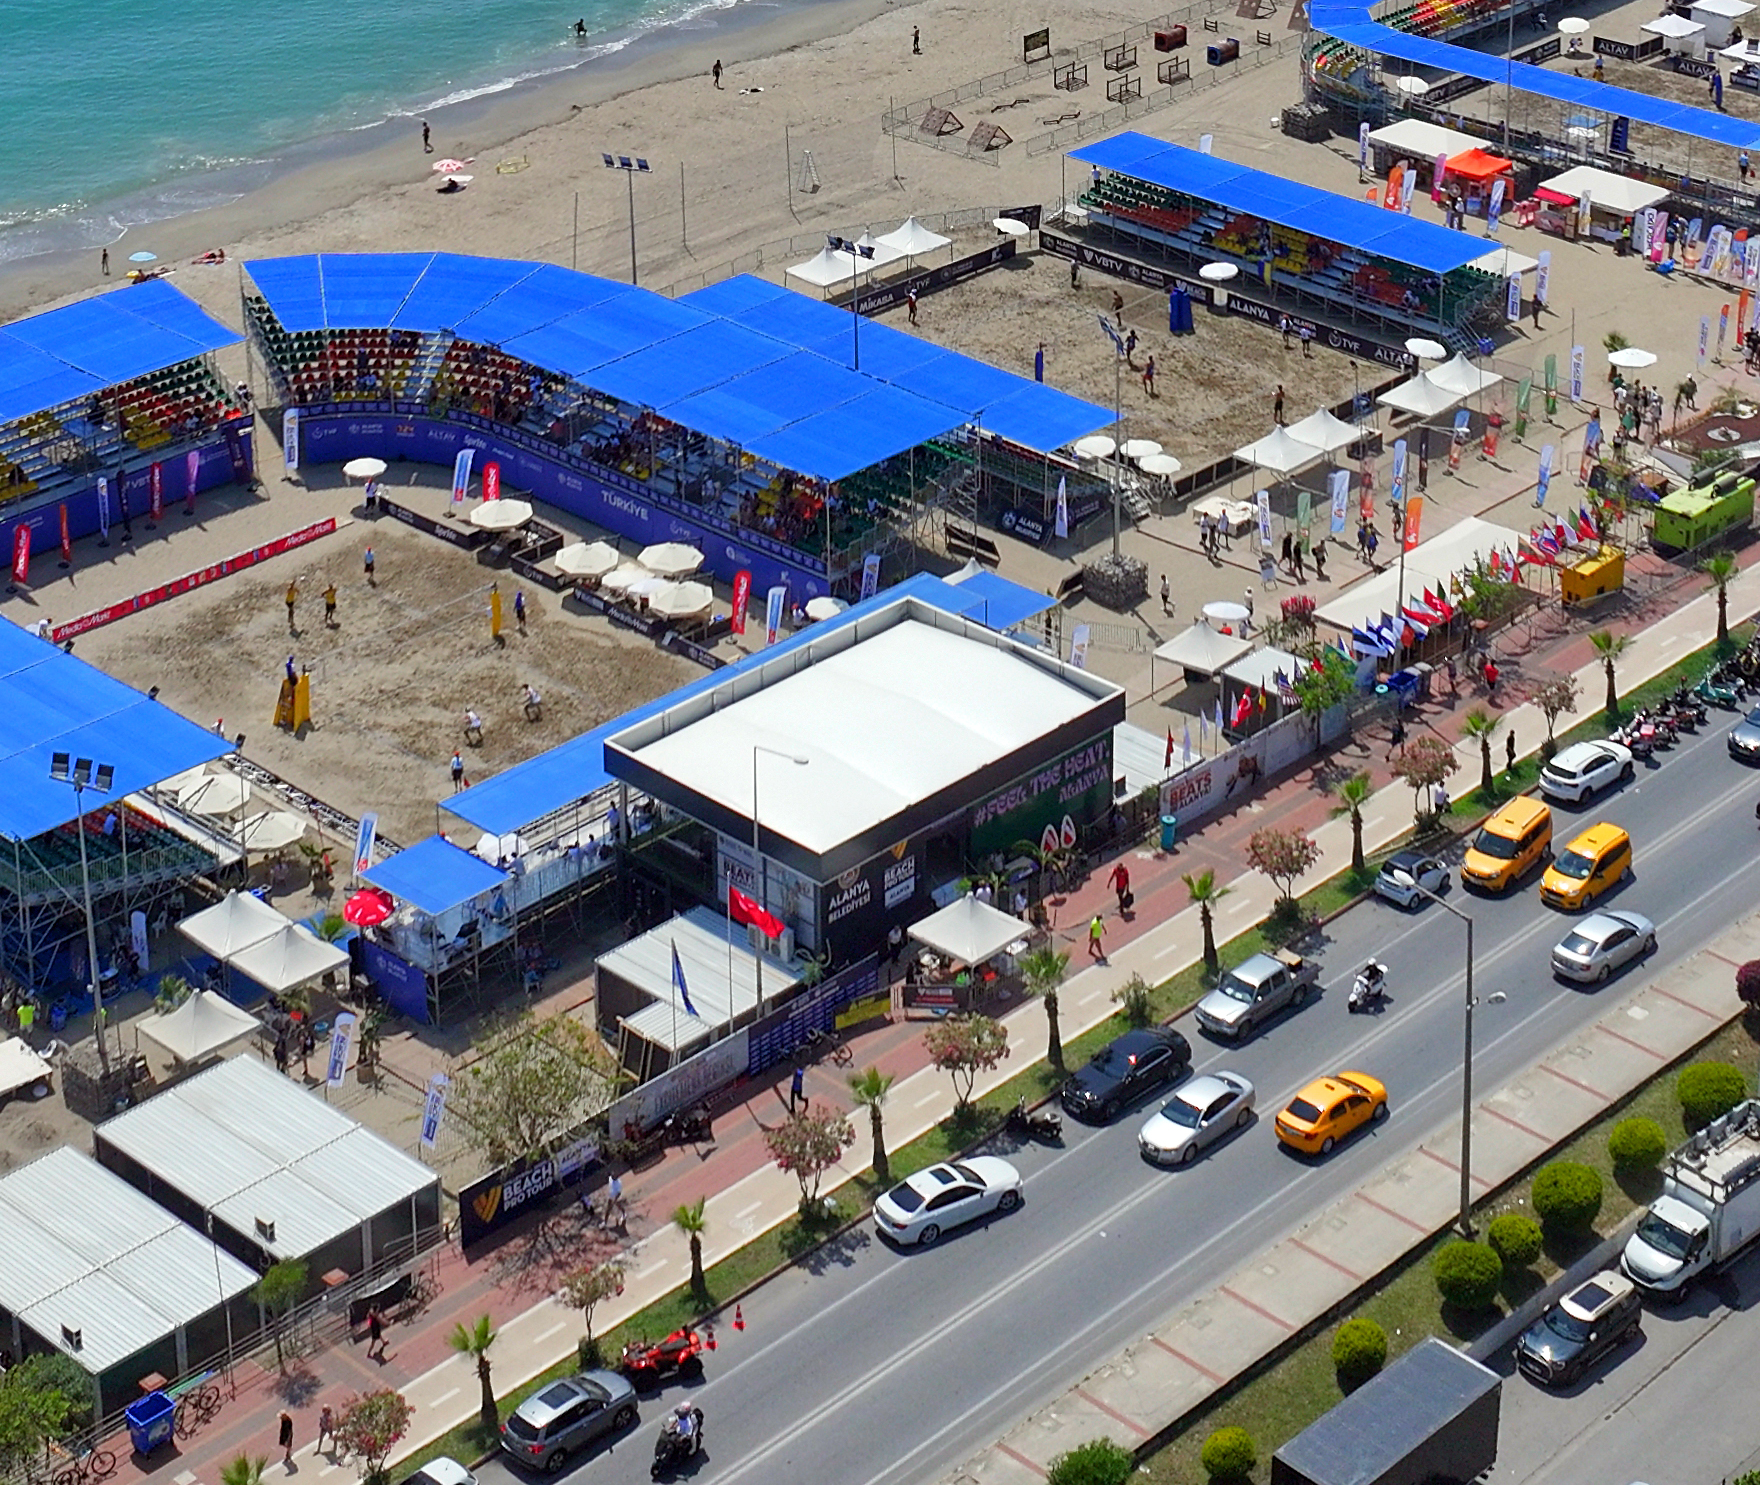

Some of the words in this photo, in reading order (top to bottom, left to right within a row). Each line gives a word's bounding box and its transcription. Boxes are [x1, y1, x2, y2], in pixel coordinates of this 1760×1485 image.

[1598, 42, 1629, 55] ALTAV
[1095, 254, 1123, 272] VBTV
[1229, 299, 1270, 322] ALANYA
[1342, 338, 1361, 352] TVF
[601, 489, 649, 522] TÜRKİYE
[884, 854, 916, 883] BEACH
[828, 878, 871, 912] ALANYA
[828, 889, 872, 925] BELEDİYESİ
[502, 1161, 553, 1202] BEACH
[504, 1192, 526, 1212] PRO
[527, 1176, 553, 1199] TOUR
